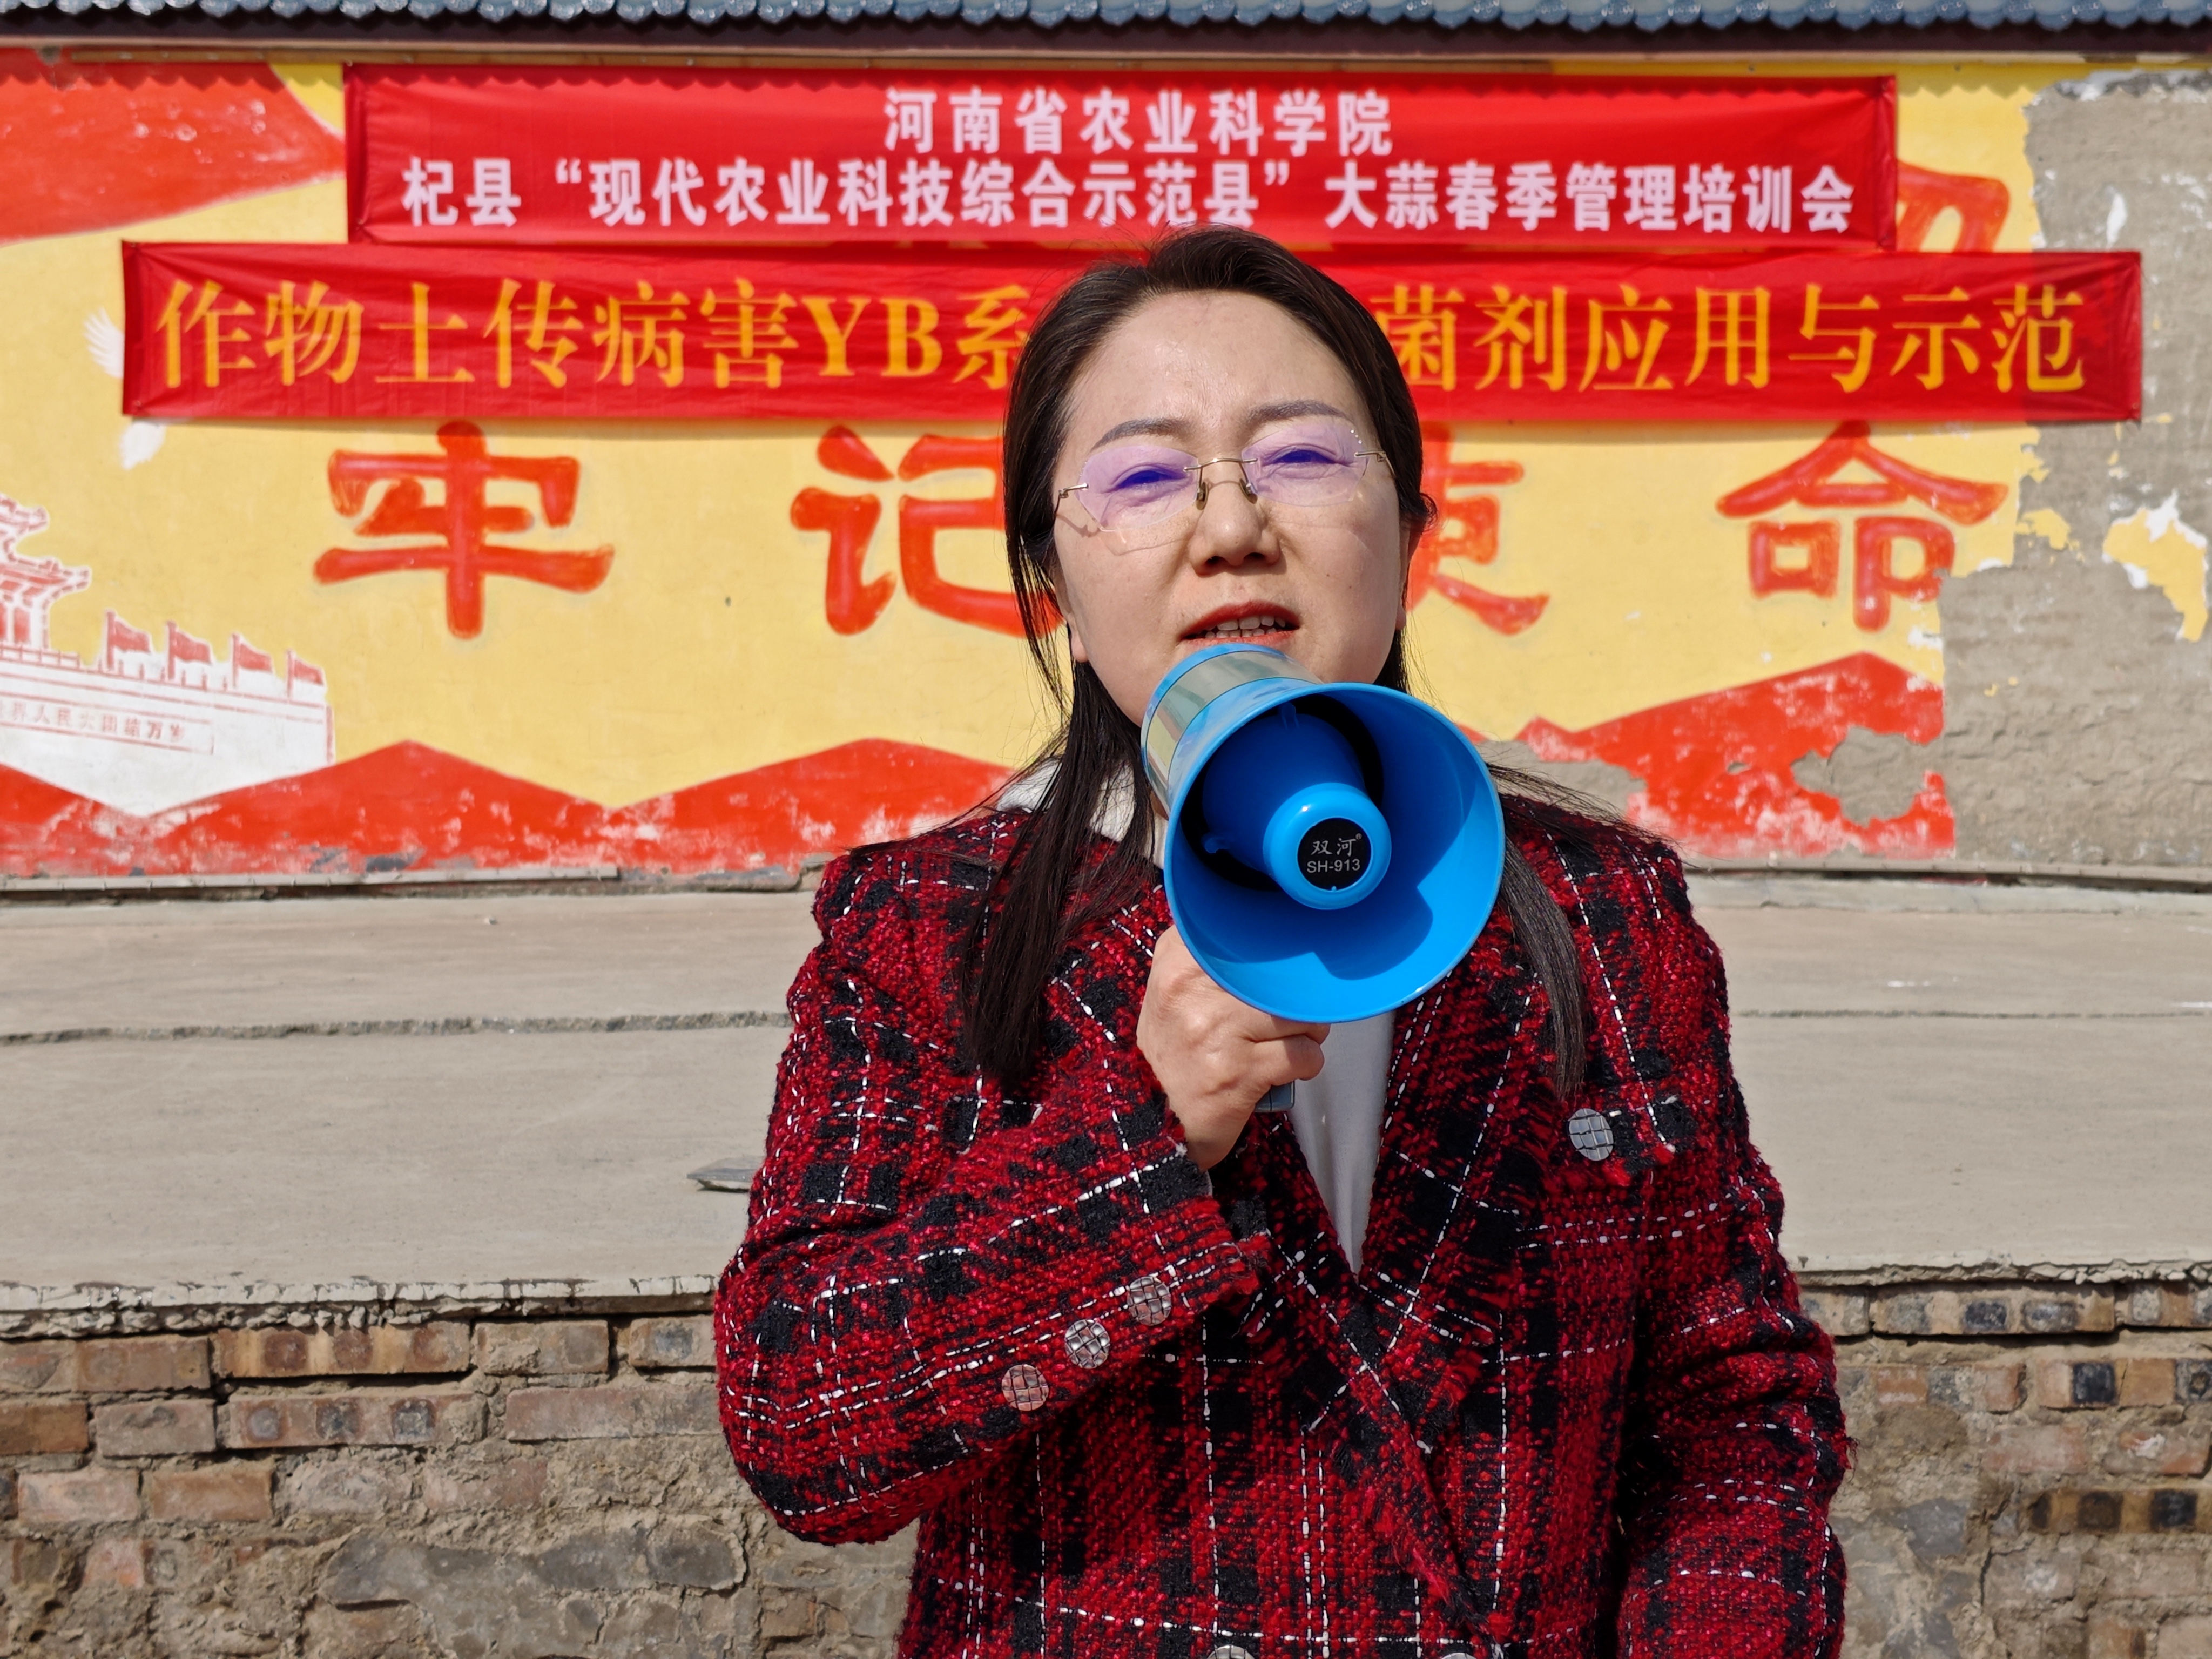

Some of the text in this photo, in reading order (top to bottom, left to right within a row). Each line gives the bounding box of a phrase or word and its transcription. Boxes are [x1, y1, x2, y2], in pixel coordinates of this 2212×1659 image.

[884, 86, 1392, 157] 河南省农业科学院
[402, 157, 522, 227] 杞县
[1324, 160, 1855, 233] 大蒜春季管理培训会
[1307, 859, 1360, 873] SH-913
[1311, 837, 1357, 857] 双河
